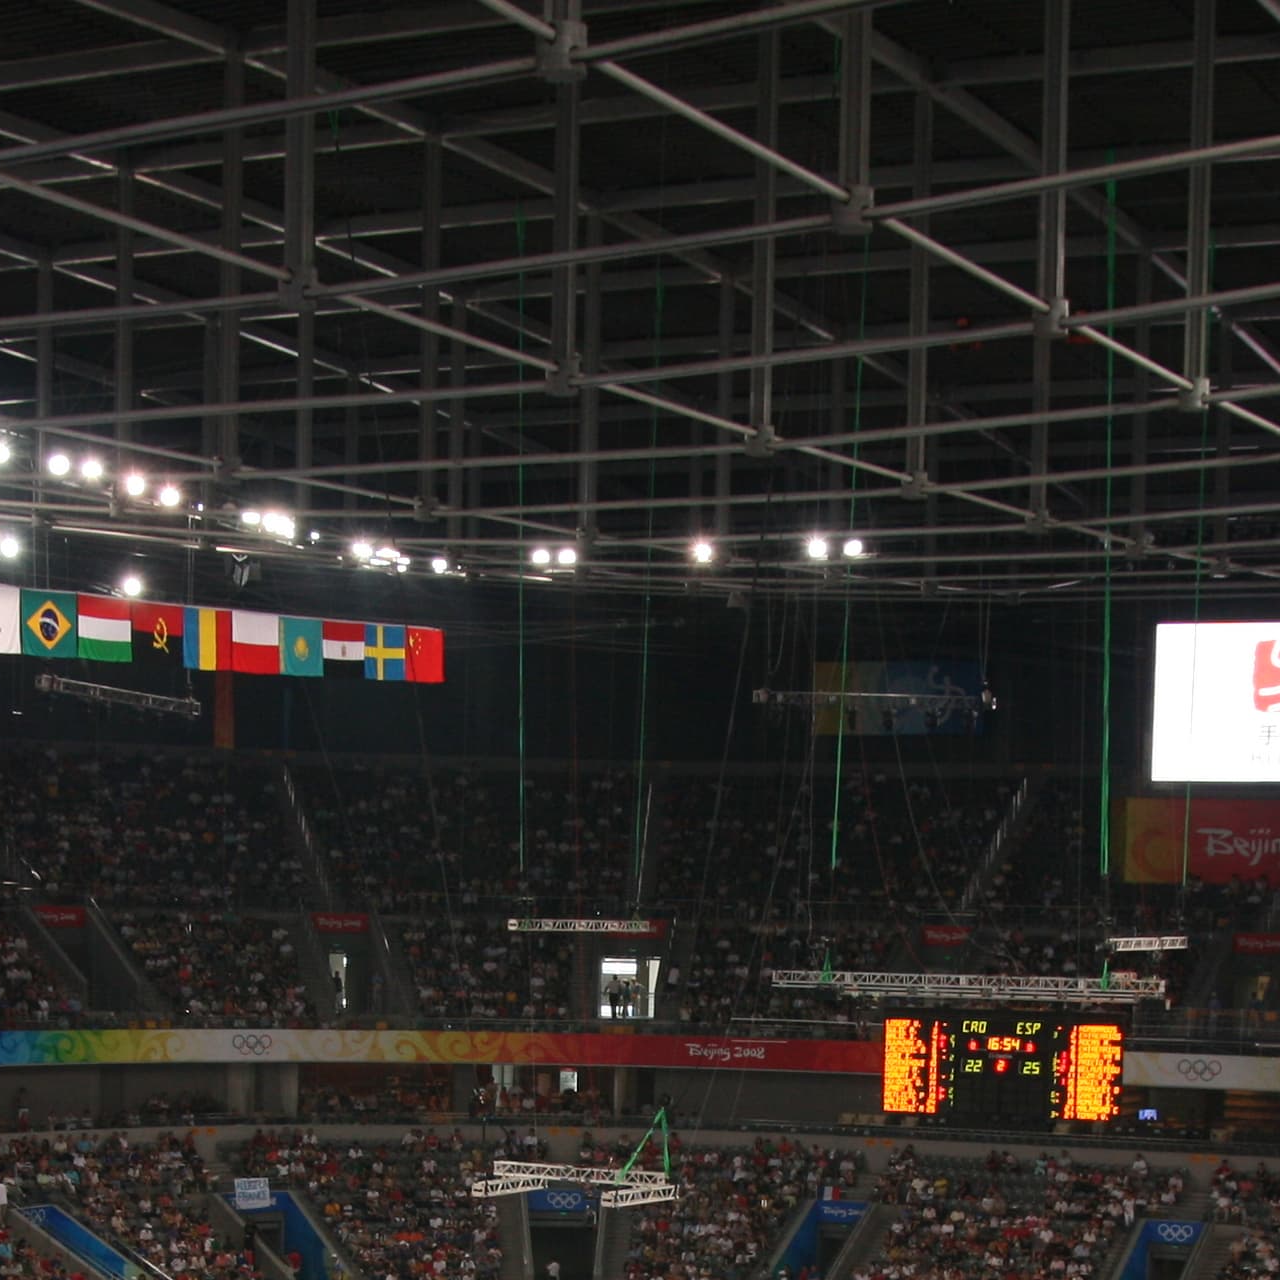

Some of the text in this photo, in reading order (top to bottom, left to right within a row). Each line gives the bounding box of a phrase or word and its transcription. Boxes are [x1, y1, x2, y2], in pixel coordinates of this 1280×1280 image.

[963, 1020, 1041, 1035] CRO ESP
[987, 1037, 1020, 1051] 16:54
[685, 1043, 766, 1061] Beijing 2008
[965, 1059, 1041, 1075] 22 2 25
